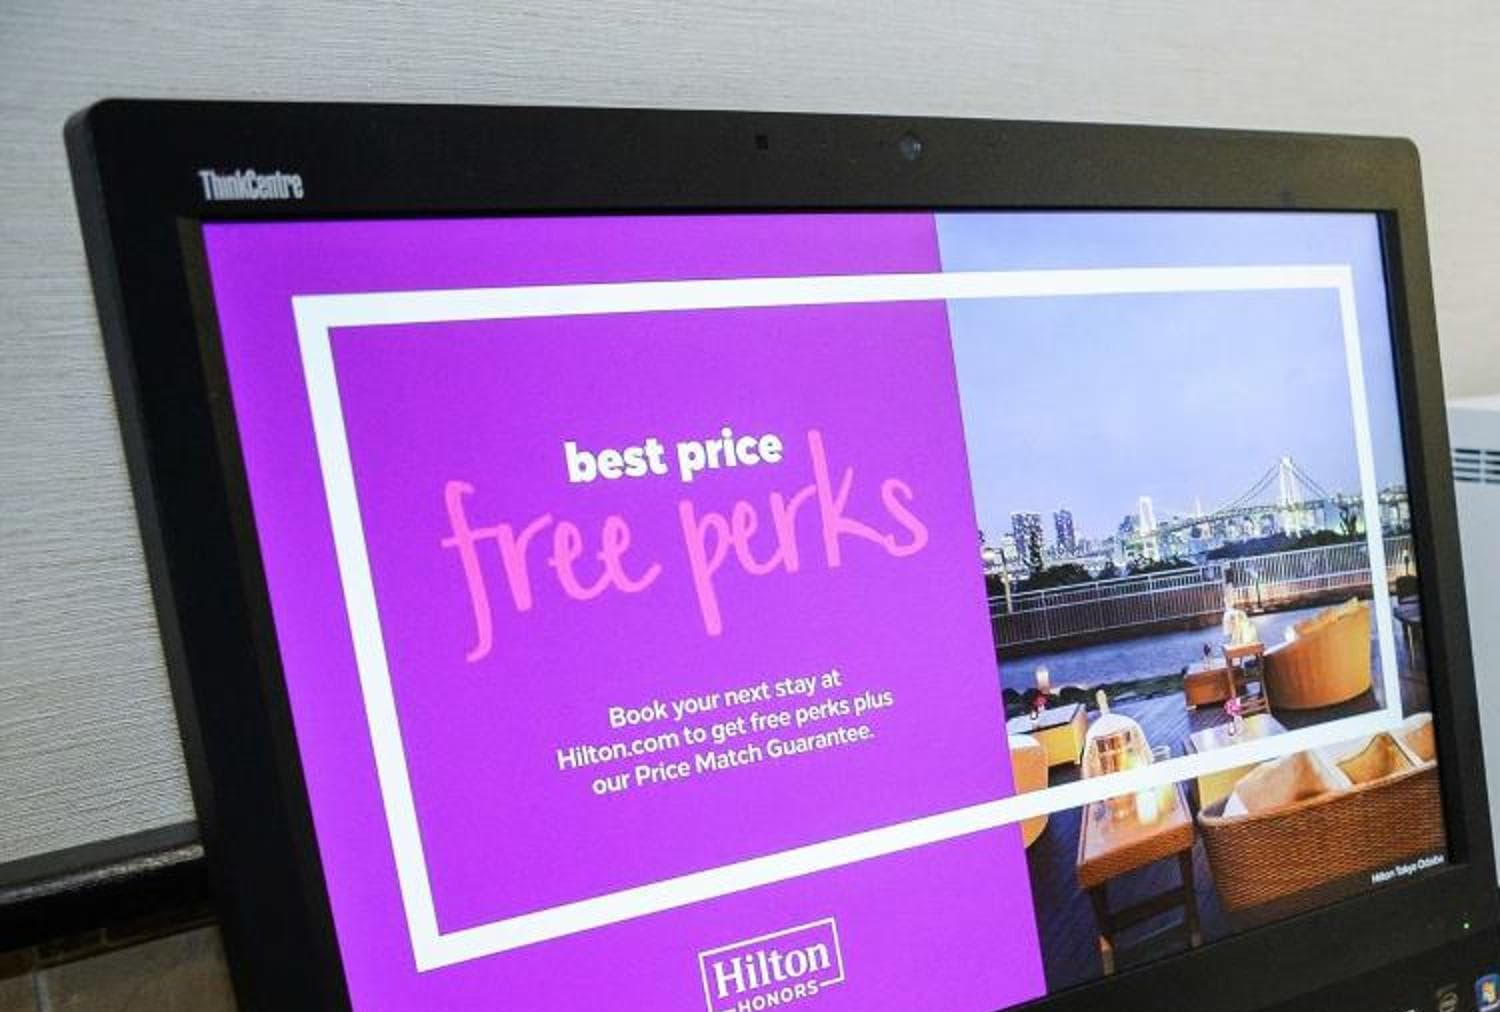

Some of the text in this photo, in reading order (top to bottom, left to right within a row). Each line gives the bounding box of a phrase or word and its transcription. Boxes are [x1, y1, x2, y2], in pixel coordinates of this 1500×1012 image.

[198, 169, 304, 199] ThinkCentre
[565, 428, 783, 482] best price
[441, 429, 929, 662] free perks
[609, 670, 841, 728] Book your next stay at
[557, 691, 893, 771] Hilton.com to get free perks plus
[592, 726, 874, 794] our Price Match Guarantee.
[713, 938, 831, 999] Hilton
